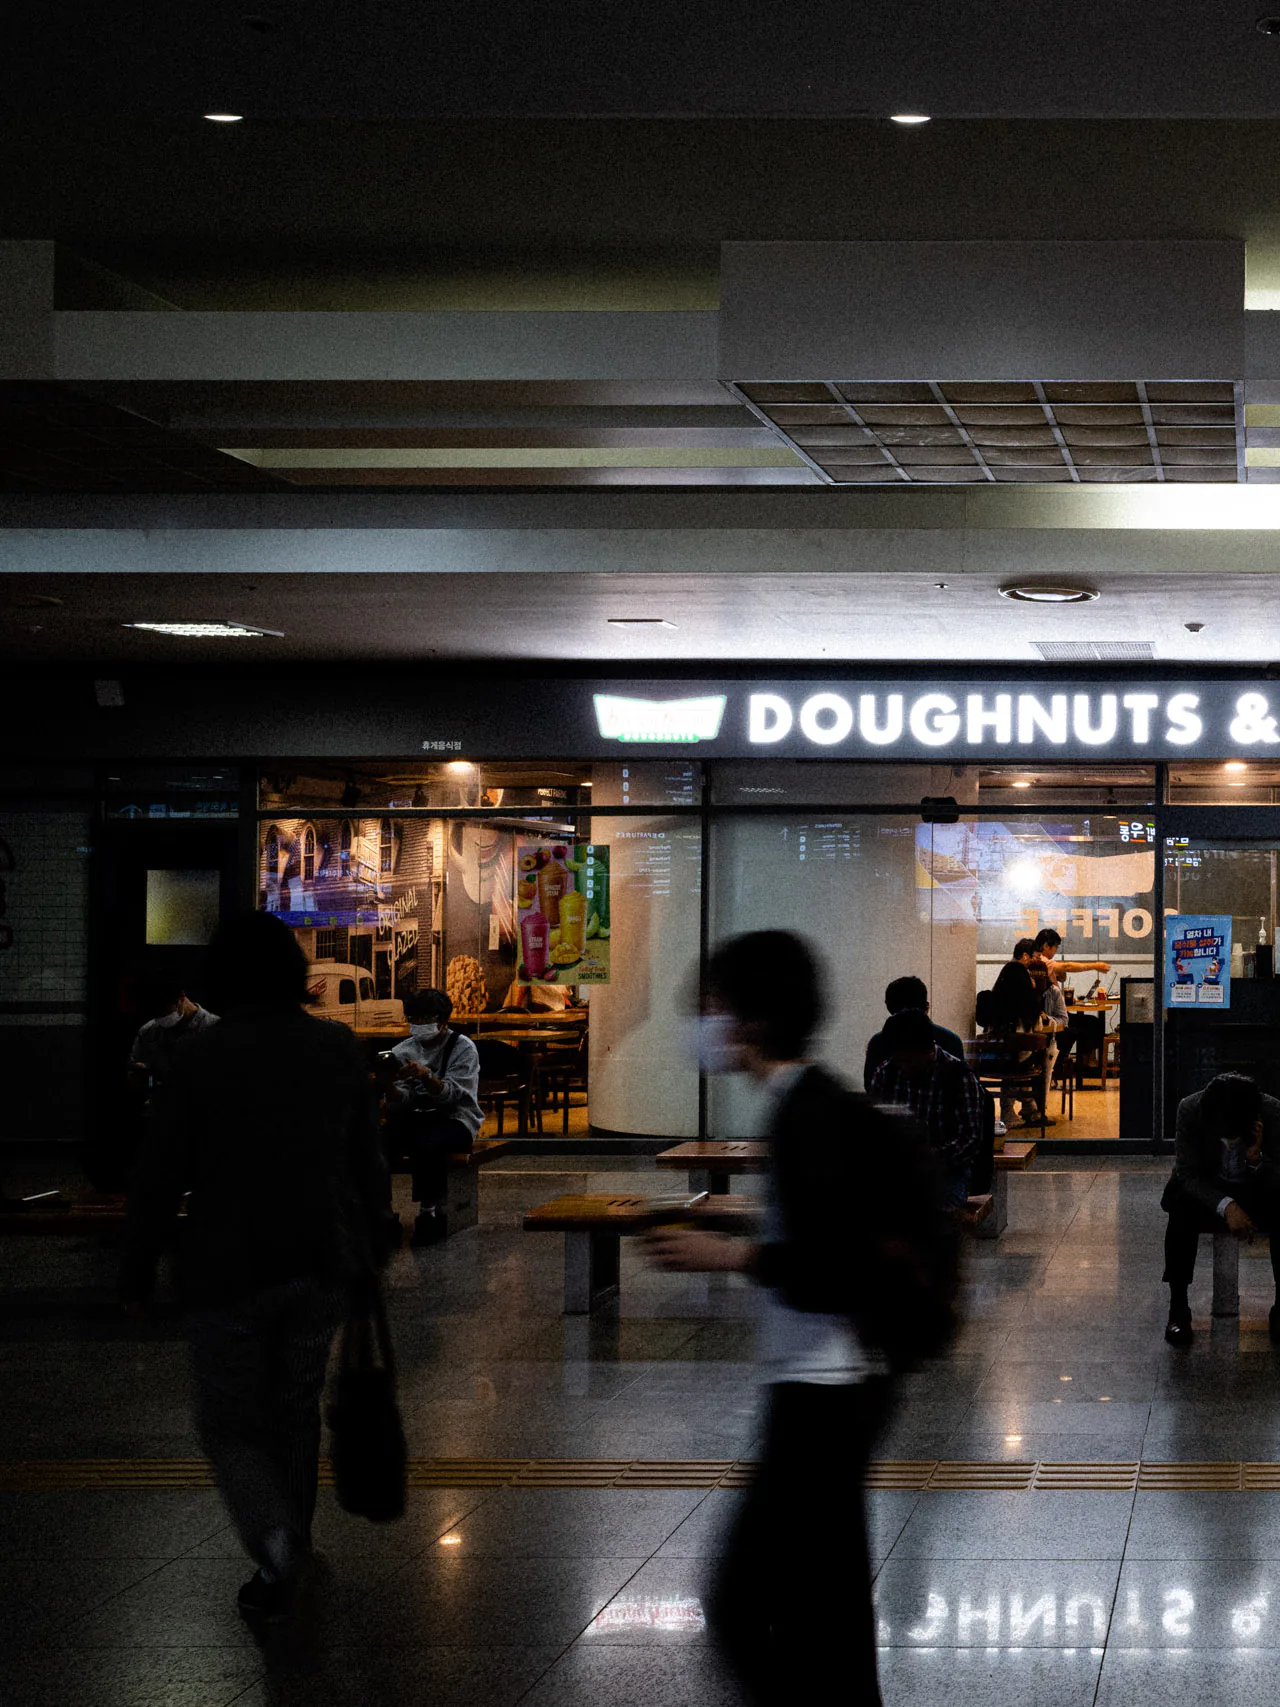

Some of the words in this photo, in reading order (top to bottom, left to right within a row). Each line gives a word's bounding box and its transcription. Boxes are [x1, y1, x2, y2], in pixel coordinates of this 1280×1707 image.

[749, 693, 1203, 745] DOUGHNUTS
[1229, 692, 1280, 744] &
[1186, 930, 1202, 939] 열차
[1203, 928, 1212, 937] 내
